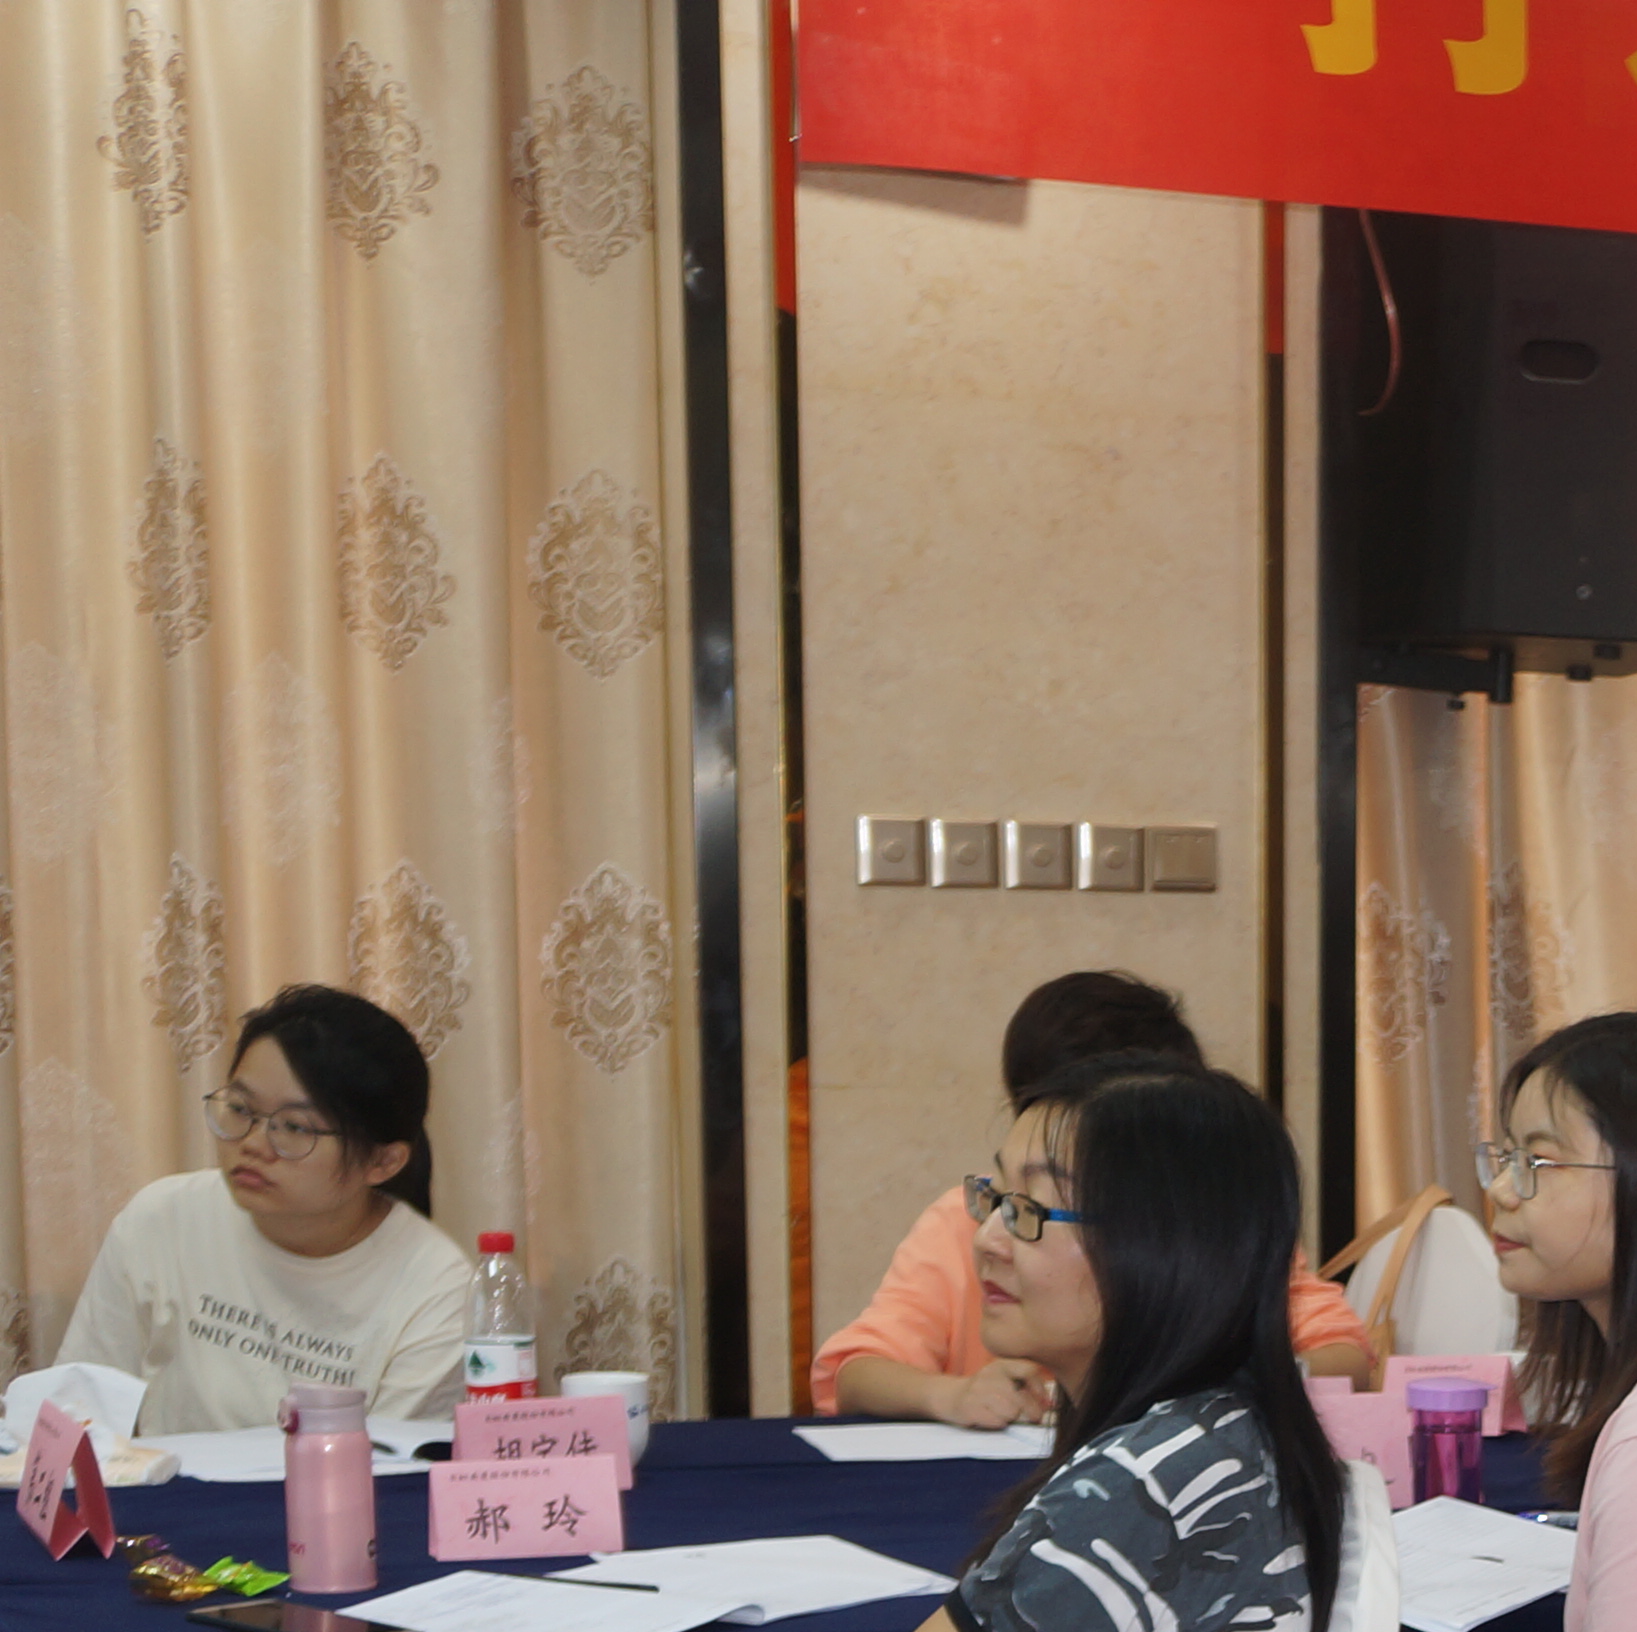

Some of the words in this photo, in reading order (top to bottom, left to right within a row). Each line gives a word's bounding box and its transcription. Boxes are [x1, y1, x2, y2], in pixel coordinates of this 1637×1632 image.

[188, 1318, 236, 1348] ONLY
[281, 1353, 355, 1386] TRUTH!
[199, 1294, 277, 1339] THERE'S
[281, 1328, 356, 1361] ALWAYS
[465, 1494, 587, 1545] 郝玲
